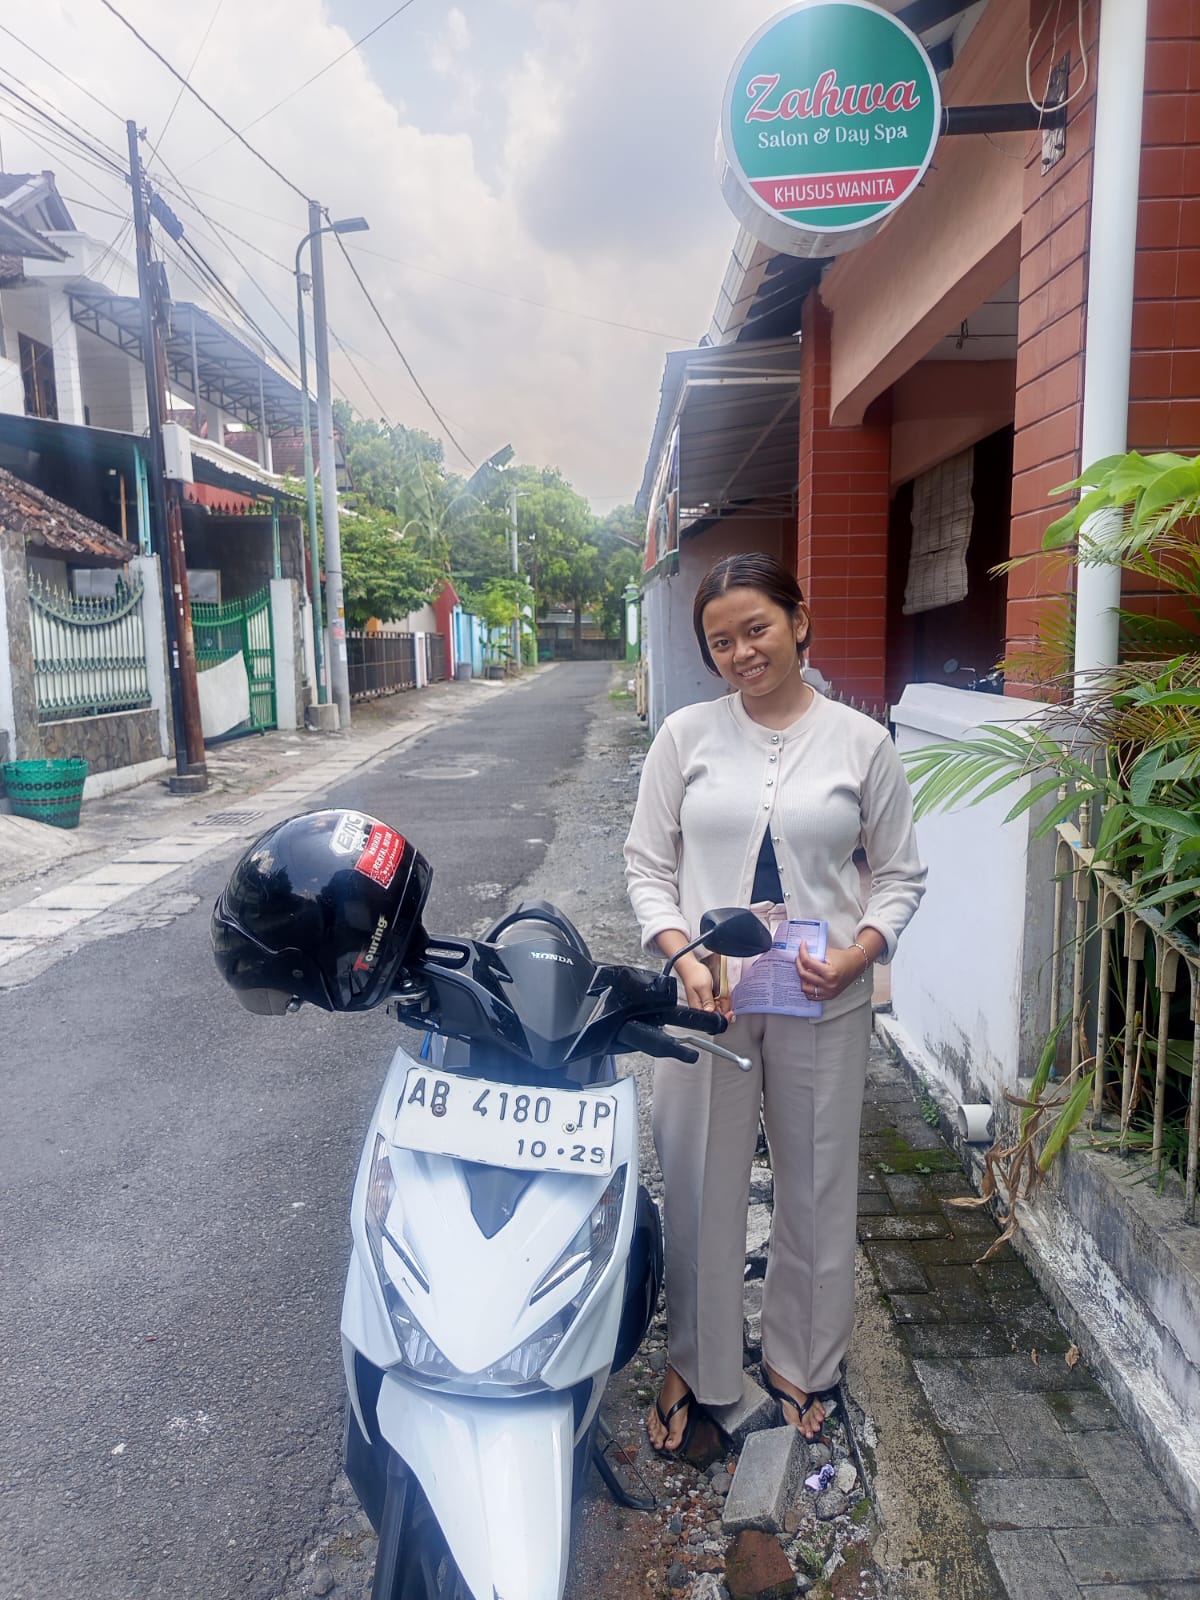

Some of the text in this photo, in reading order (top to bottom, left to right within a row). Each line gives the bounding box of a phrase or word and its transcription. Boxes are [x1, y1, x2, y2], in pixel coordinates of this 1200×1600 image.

[745, 69, 920, 123] Zahwa
[758, 123, 908, 149] Salon & Day Spa
[774, 178, 895, 203] KHUSUS WANITA
[352, 912, 388, 971] Touring
[530, 951, 575, 966] HONDA
[407, 1077, 450, 1112] AB
[472, 1088, 551, 1124] 4180
